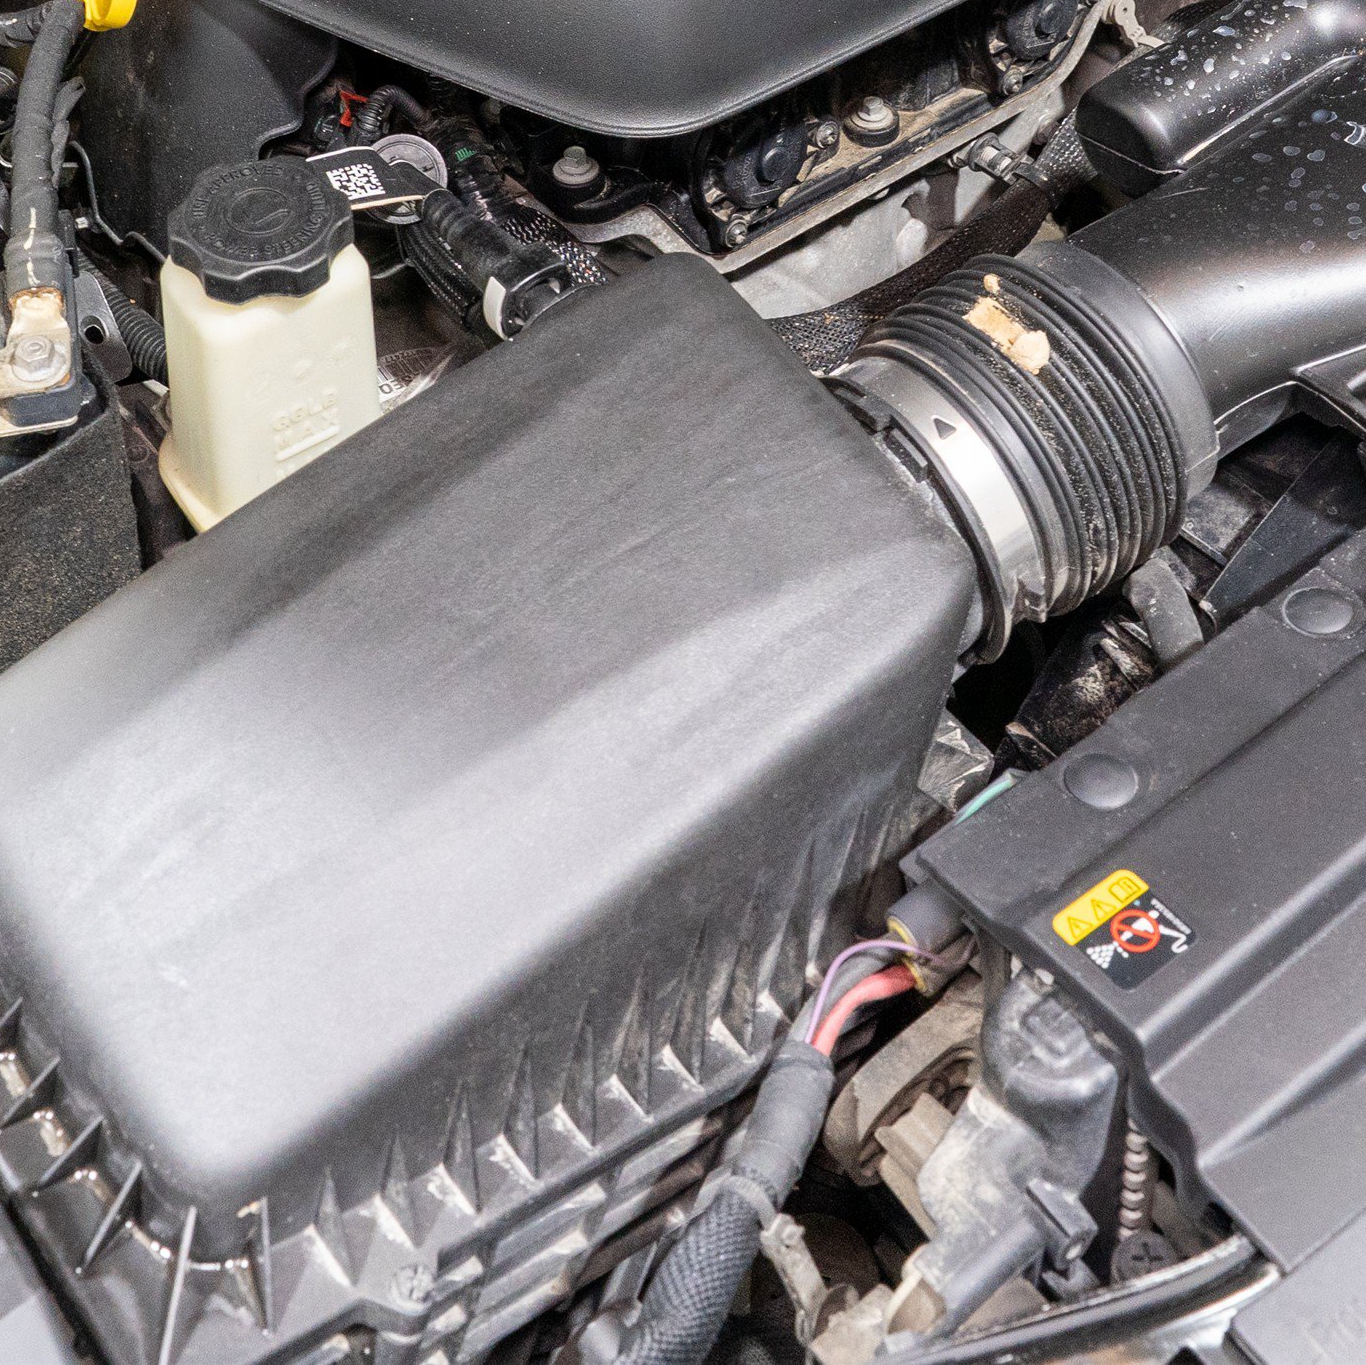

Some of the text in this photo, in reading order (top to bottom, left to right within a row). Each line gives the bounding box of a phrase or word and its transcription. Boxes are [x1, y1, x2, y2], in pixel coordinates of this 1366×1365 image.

[209, 164, 284, 195] APPROVED
[203, 233, 260, 256] POWER
[264, 215, 325, 256] STEERING
